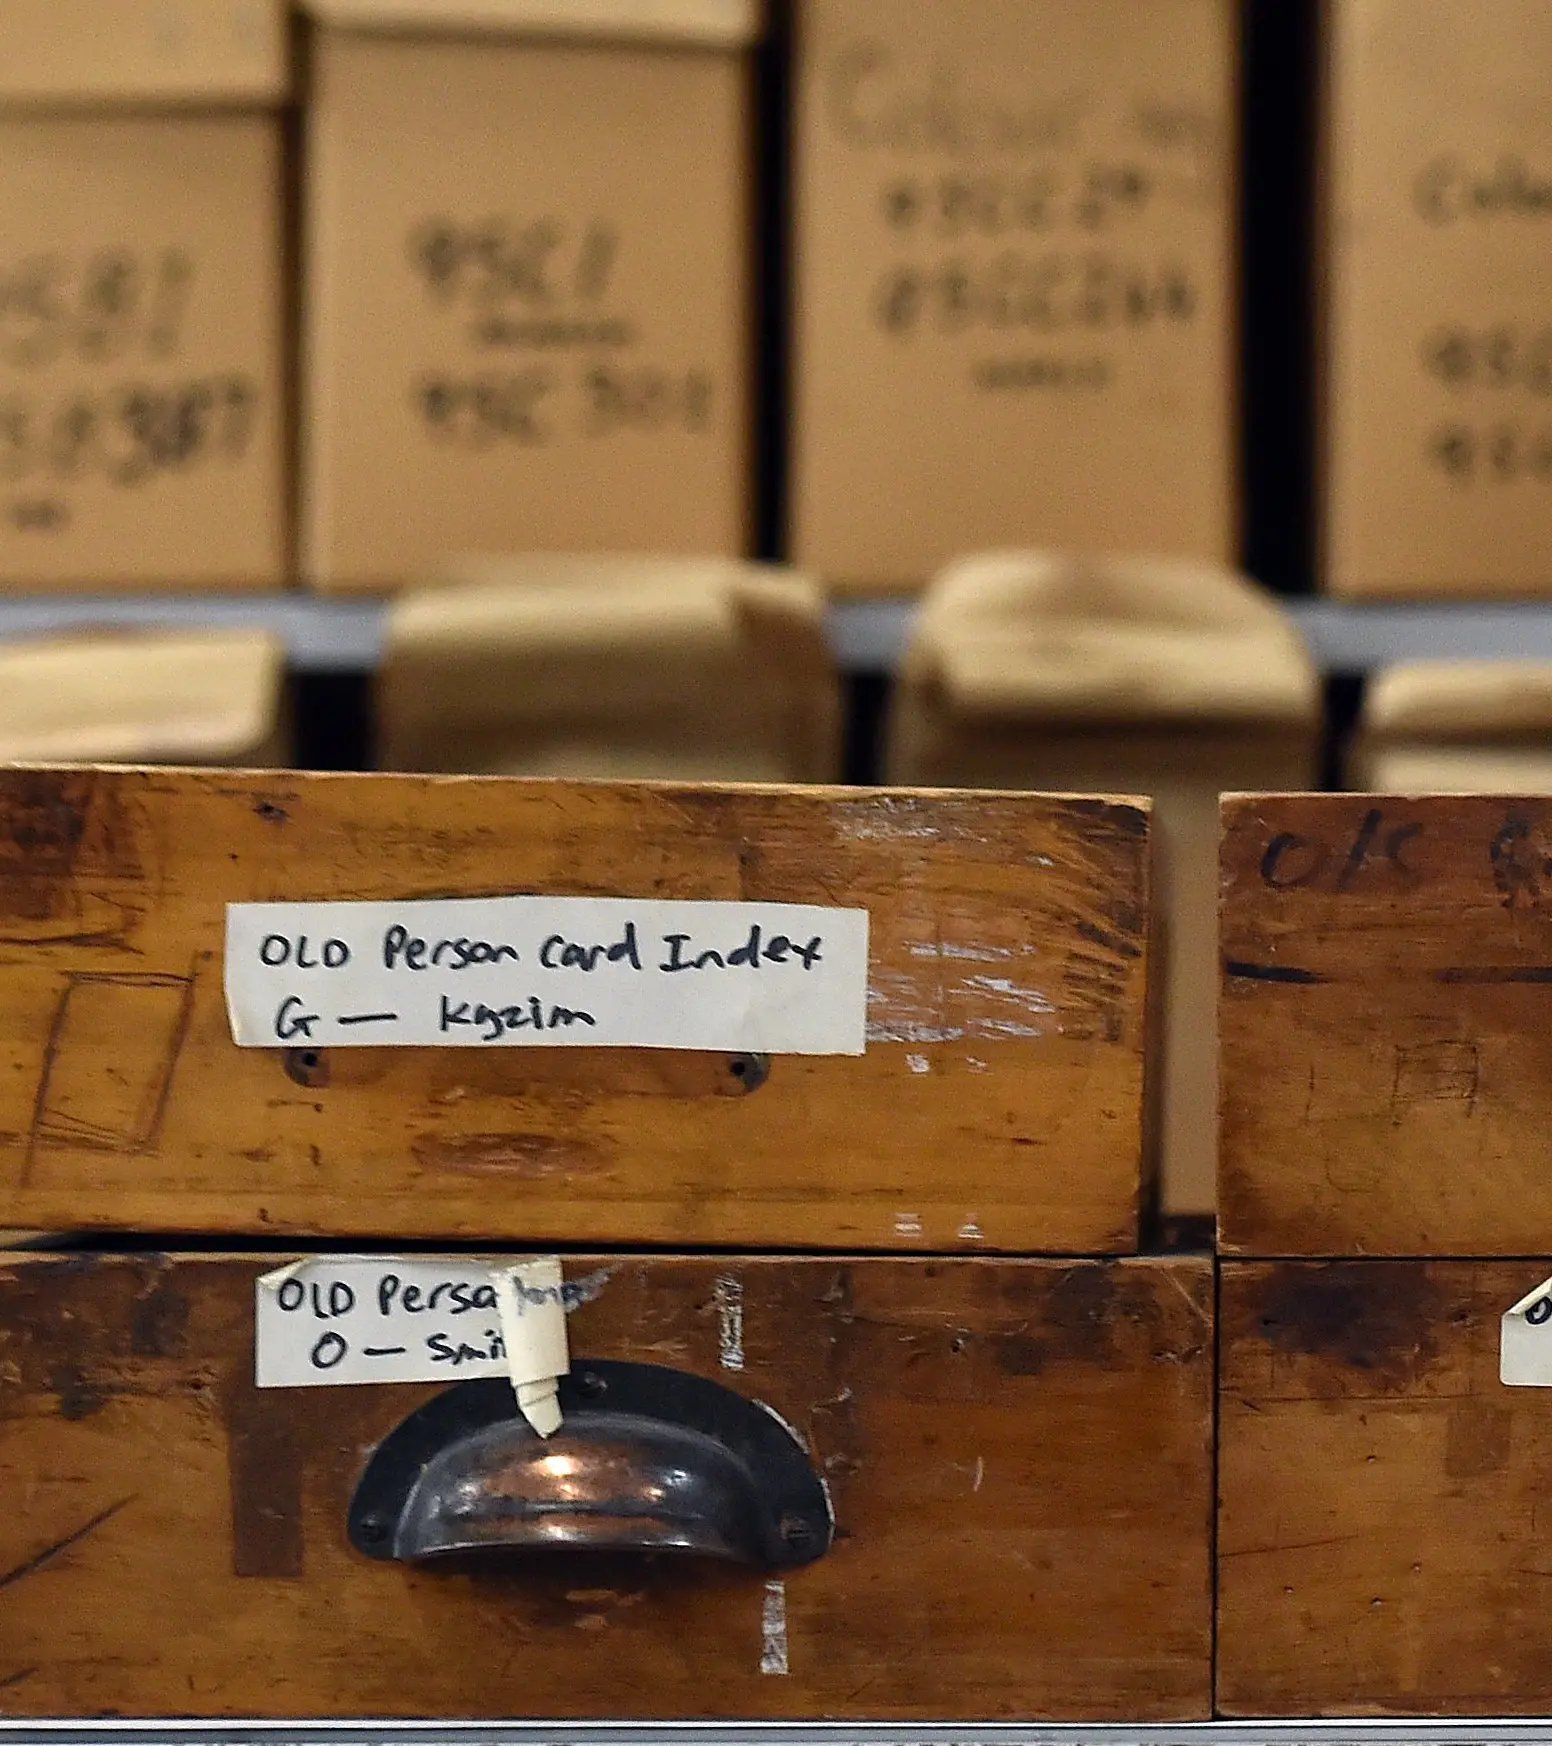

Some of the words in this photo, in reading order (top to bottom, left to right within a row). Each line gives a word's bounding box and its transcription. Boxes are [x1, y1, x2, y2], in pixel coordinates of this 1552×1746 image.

[260, 934, 350, 969] OLD
[384, 924, 519, 971] Person
[540, 922, 642, 972] Card
[660, 925, 822, 973] Index
[275, 996, 321, 1040] G
